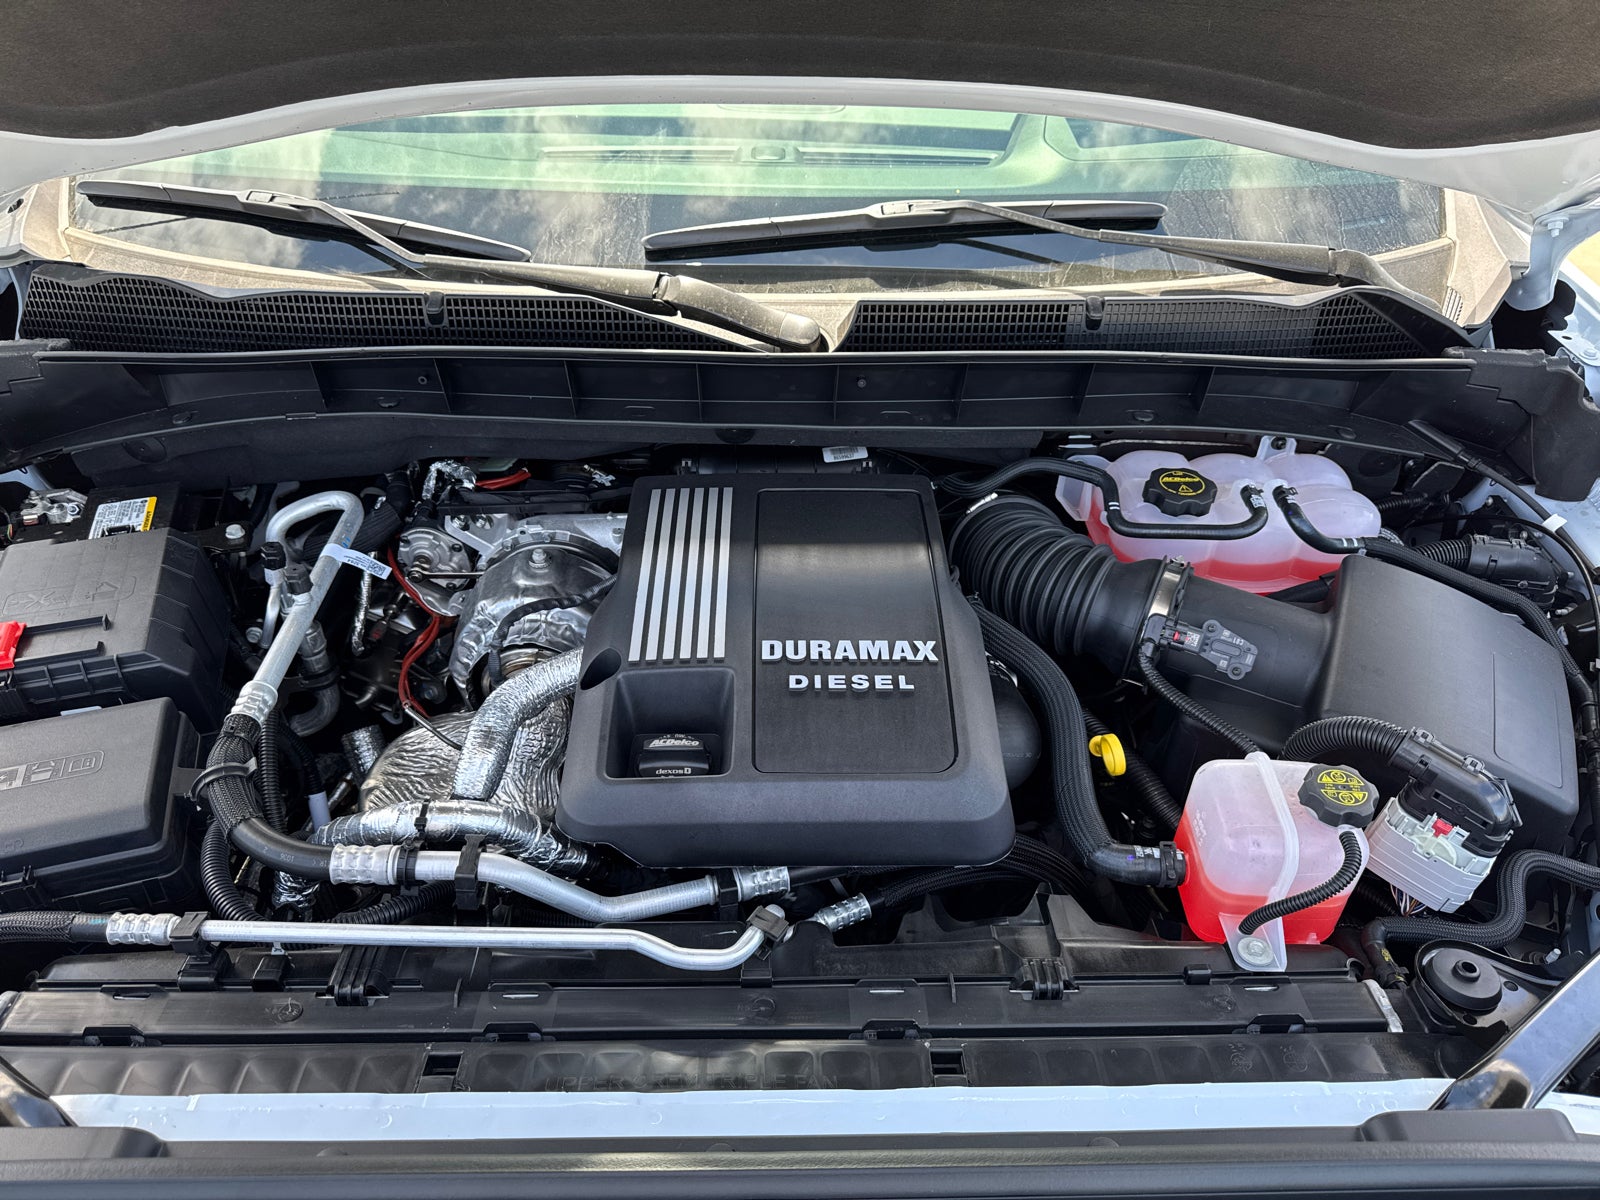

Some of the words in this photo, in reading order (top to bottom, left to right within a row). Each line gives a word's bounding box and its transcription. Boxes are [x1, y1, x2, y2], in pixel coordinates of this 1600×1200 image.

[761, 640, 939, 663] DURAMAX
[788, 674, 915, 691] DIESEL
[648, 738, 700, 748] ACDelco
